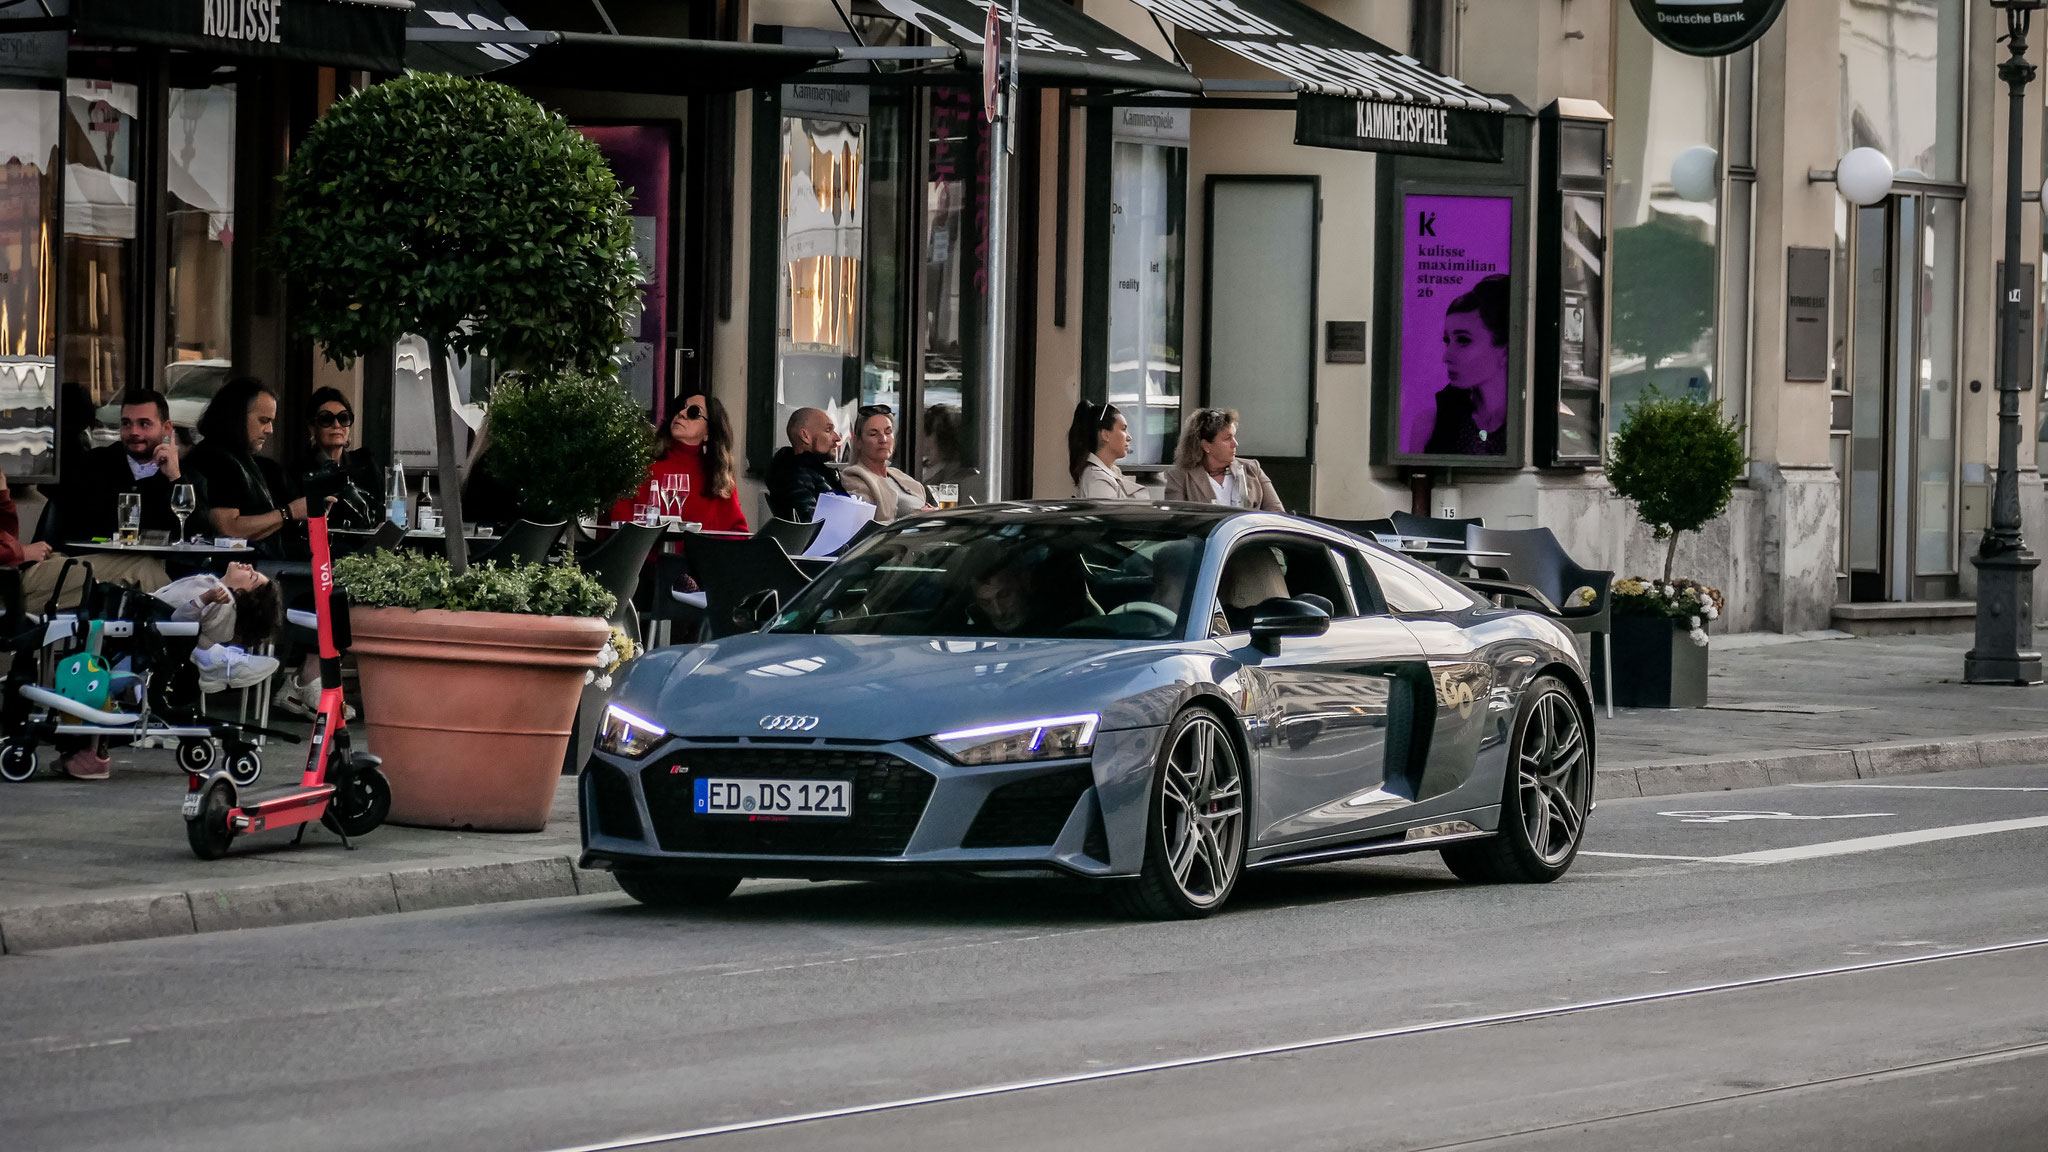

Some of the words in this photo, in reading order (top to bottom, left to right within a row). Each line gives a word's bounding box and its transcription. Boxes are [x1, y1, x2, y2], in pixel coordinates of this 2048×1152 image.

[203, 0, 281, 43] KULISSE
[1657, 12, 1711, 24] Deutsche
[1713, 11, 1745, 23] Bank
[793, 84, 850, 106] Kammerspiele
[1123, 108, 1174, 132] Kammerspiele
[1357, 101, 1448, 145] KAMMERSPIELE
[1418, 245, 1465, 257] kulisse
[1150, 261, 1159, 273] let
[1418, 259, 1496, 271] maximilian
[1119, 279, 1140, 292] reality
[1417, 274, 1463, 284] strasse
[1417, 287, 1434, 297] 26
[1444, 509, 1455, 518] 15
[709, 783, 741, 810] ED
[759, 783, 791, 811] DS
[798, 784, 847, 812] 121
